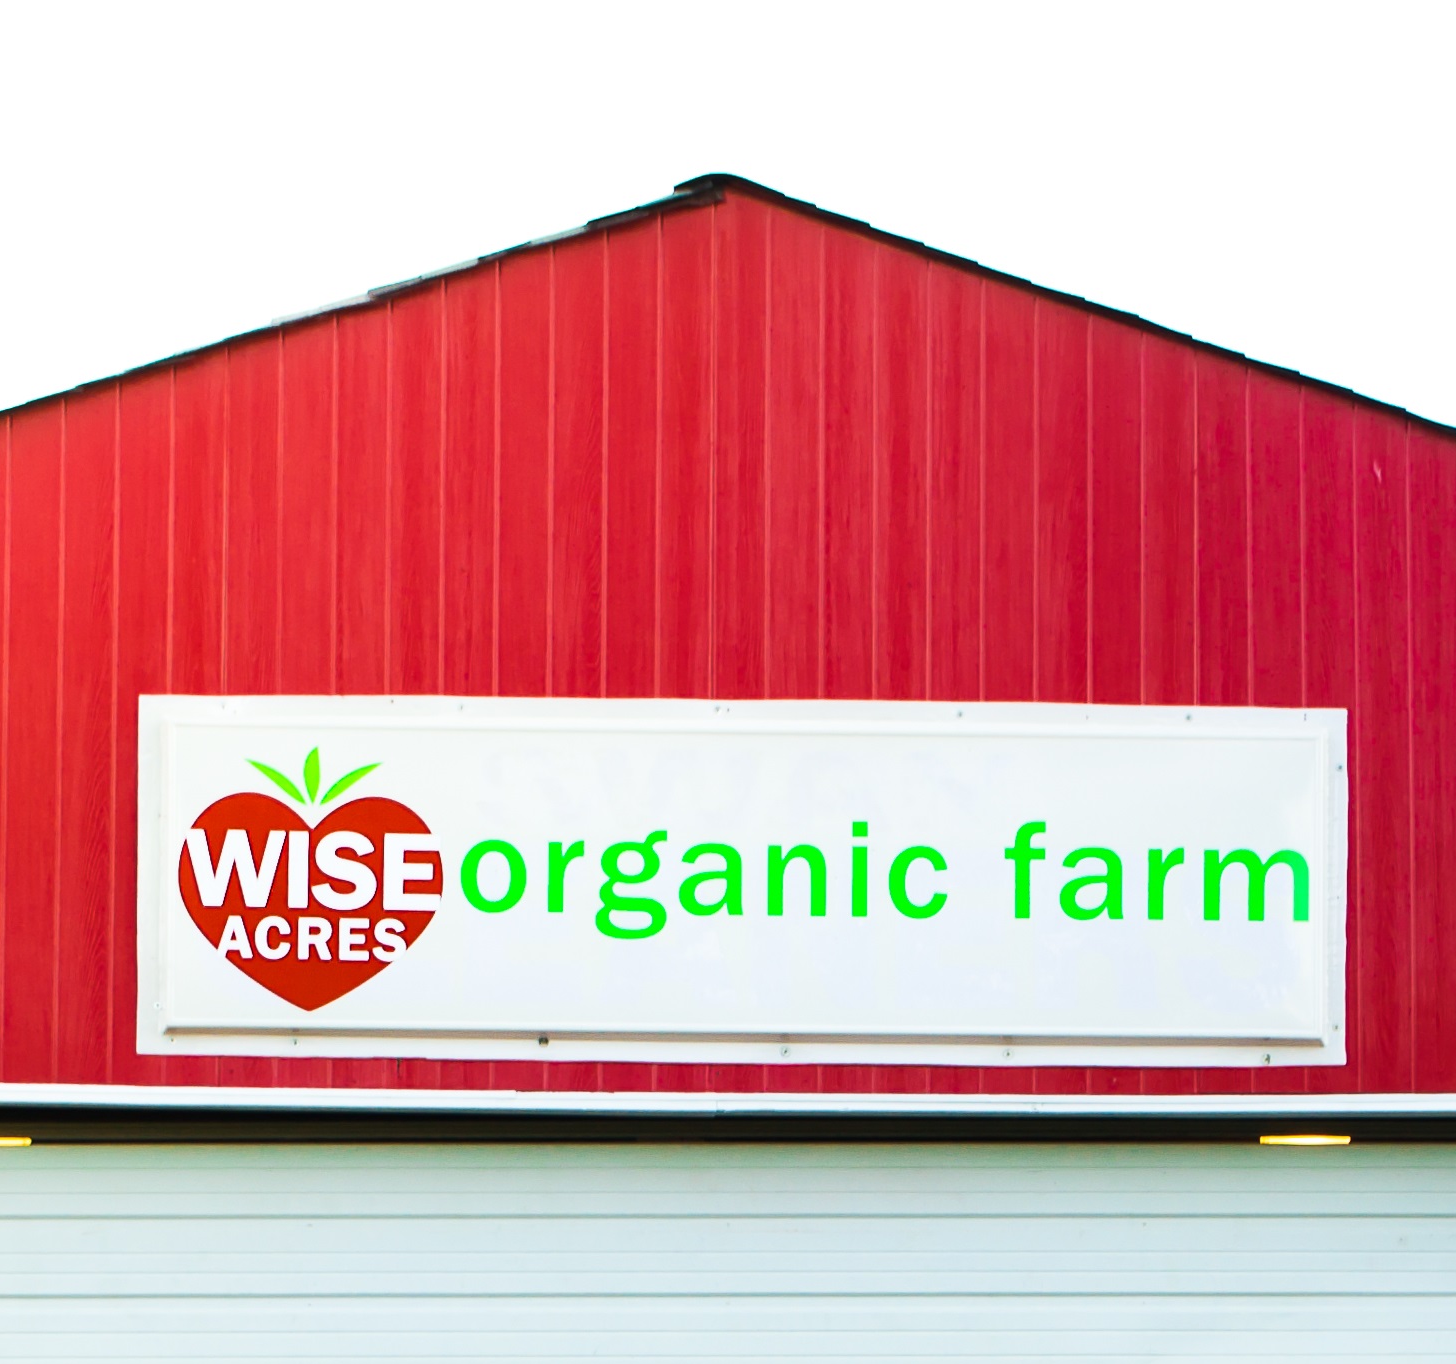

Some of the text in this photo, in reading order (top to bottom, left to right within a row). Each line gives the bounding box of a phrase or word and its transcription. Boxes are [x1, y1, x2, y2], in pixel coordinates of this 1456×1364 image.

[182, 828, 442, 911] WISE
[461, 821, 1309, 939] organic farm
[217, 915, 406, 962] ACRES
